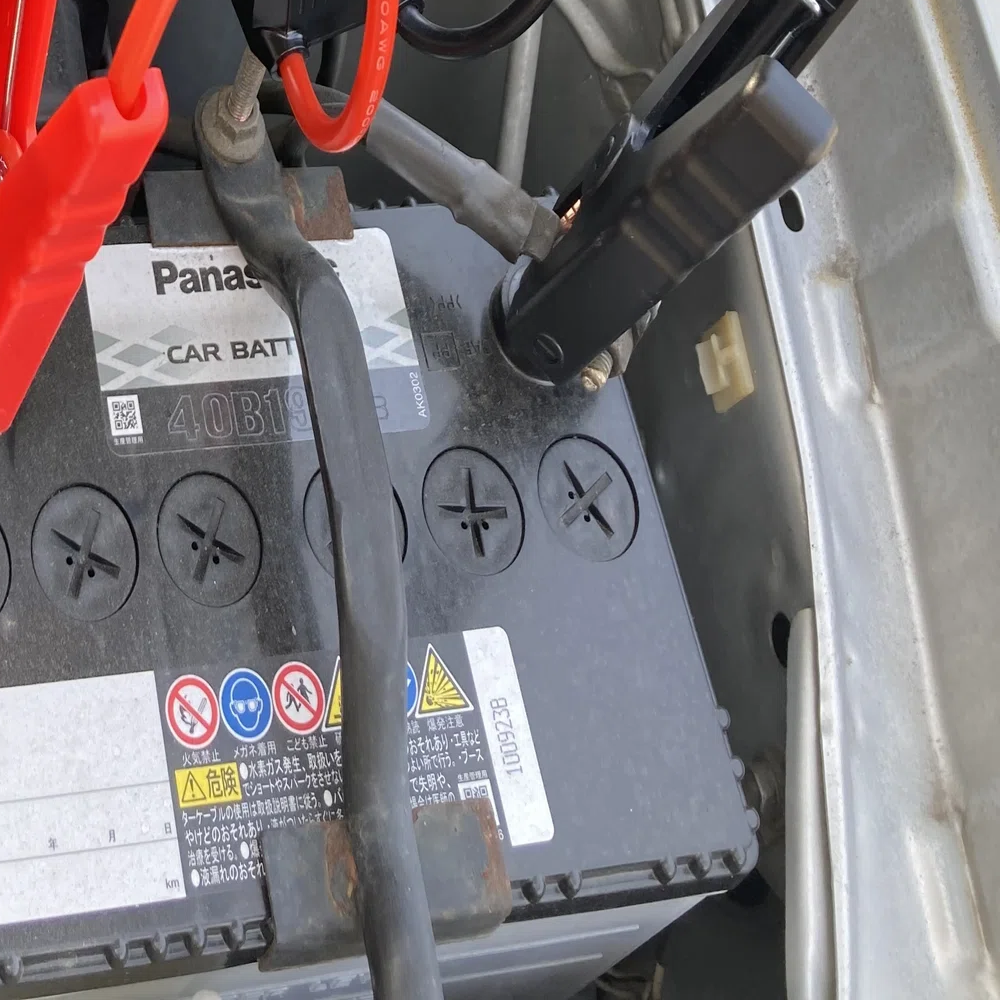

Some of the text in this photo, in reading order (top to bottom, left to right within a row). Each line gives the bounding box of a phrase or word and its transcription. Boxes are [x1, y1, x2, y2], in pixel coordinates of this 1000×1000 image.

[151, 260, 262, 295] Panas
[167, 336, 296, 364] CAR BATT
[409, 371, 427, 418] AK0302
[182, 751, 221, 766] 火気禁止
[233, 741, 277, 759] メガネ着用
[287, 734, 328, 751] こども禁止
[427, 715, 465, 732] 爆発注意
[206, 766, 239, 798] 危険
[48, 838, 58, 850] 年
[108, 829, 116, 843] 月
[164, 822, 172, 835] 日
[165, 878, 180, 891] km
